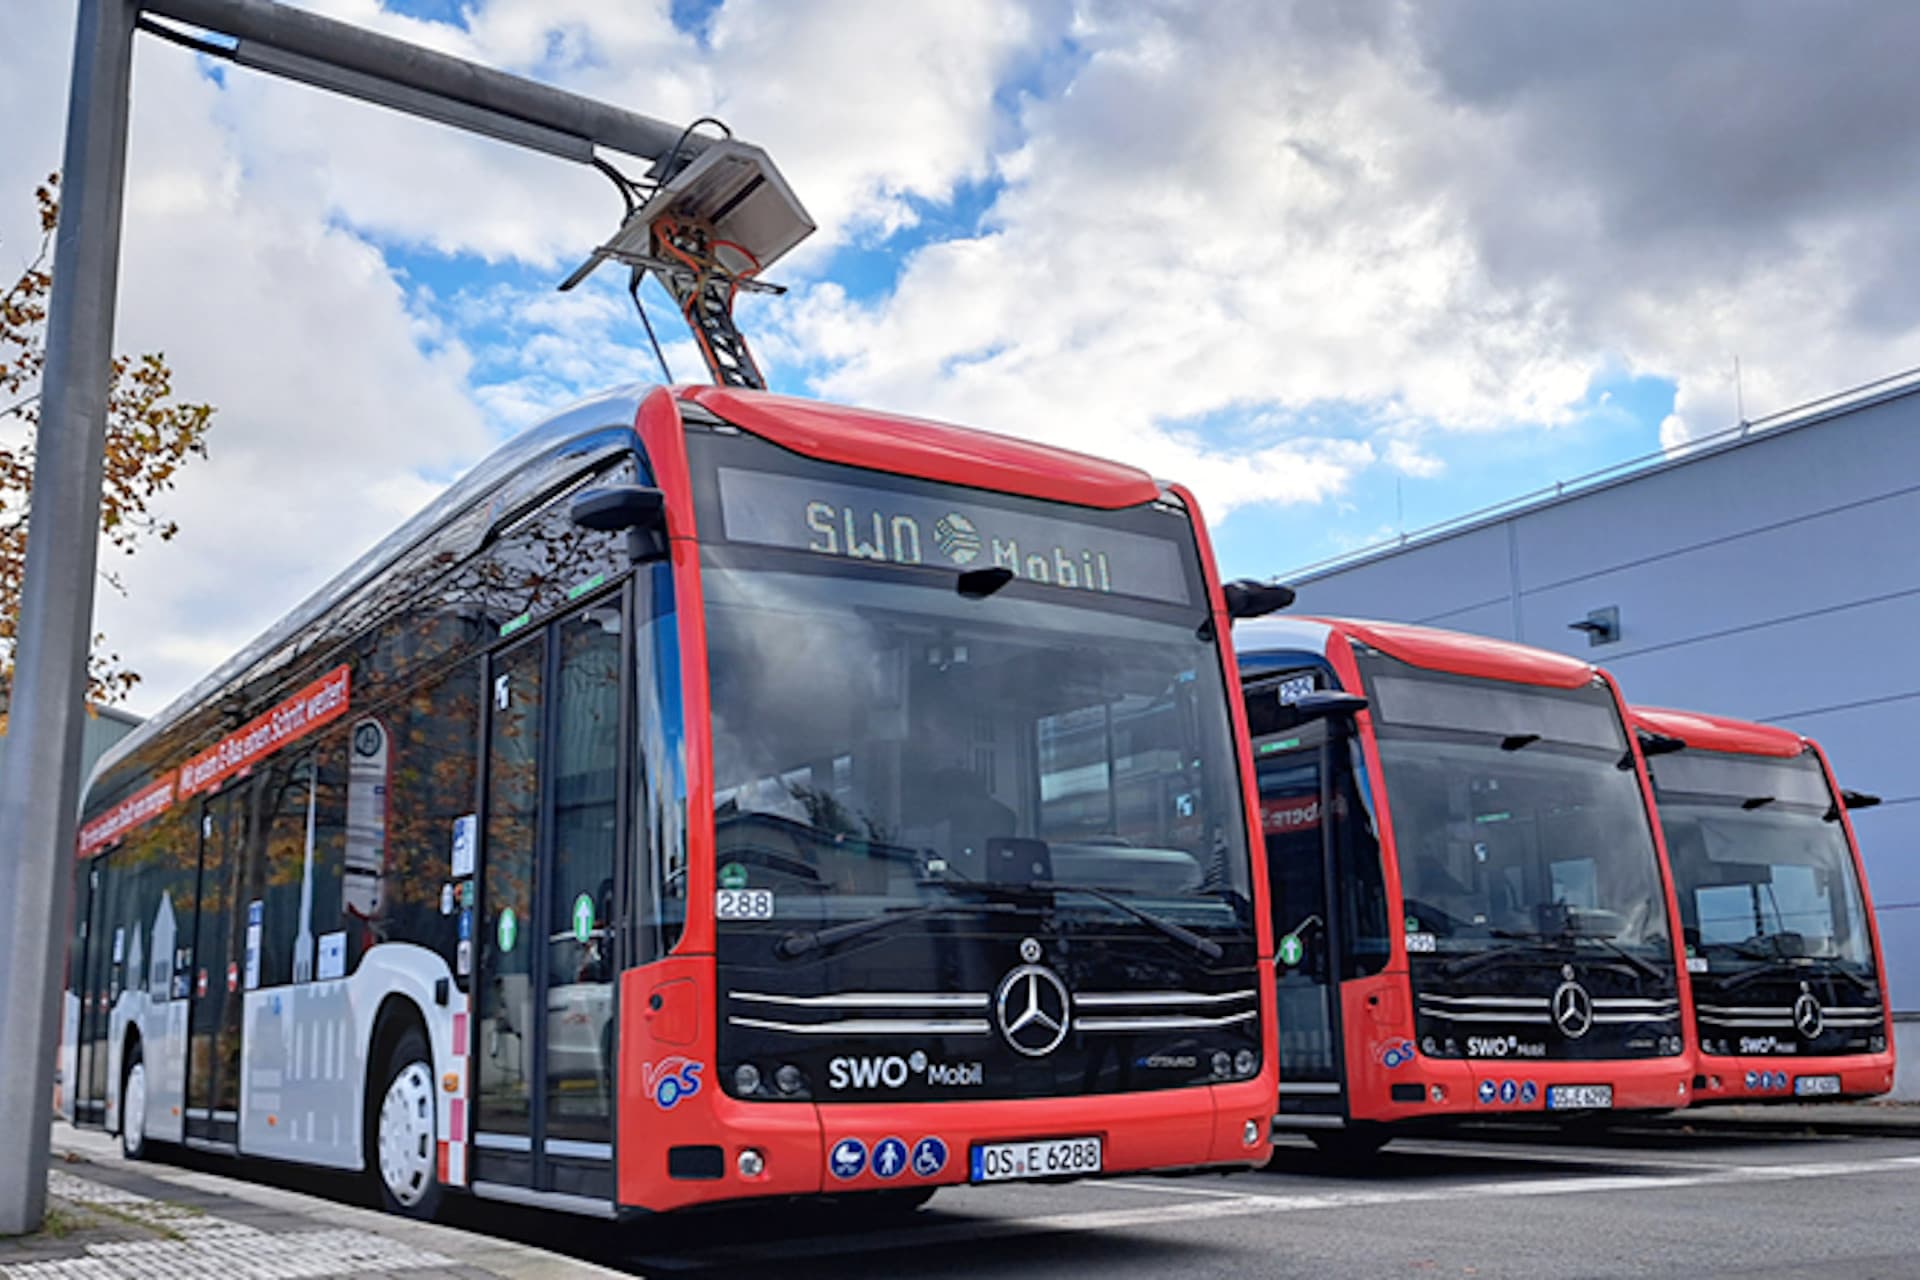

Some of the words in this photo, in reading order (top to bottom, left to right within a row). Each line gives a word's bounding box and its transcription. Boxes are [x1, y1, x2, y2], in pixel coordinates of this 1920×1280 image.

[991, 538, 1111, 591] Mobil
[720, 891, 768, 917] 288
[1467, 1036, 1508, 1057] SWO
[829, 1055, 908, 1089] SWO
[927, 1062, 983, 1086] Mobil
[986, 1149, 1014, 1175] OS
[1027, 1147, 1041, 1171] E
[1047, 1142, 1098, 1170] 6288
